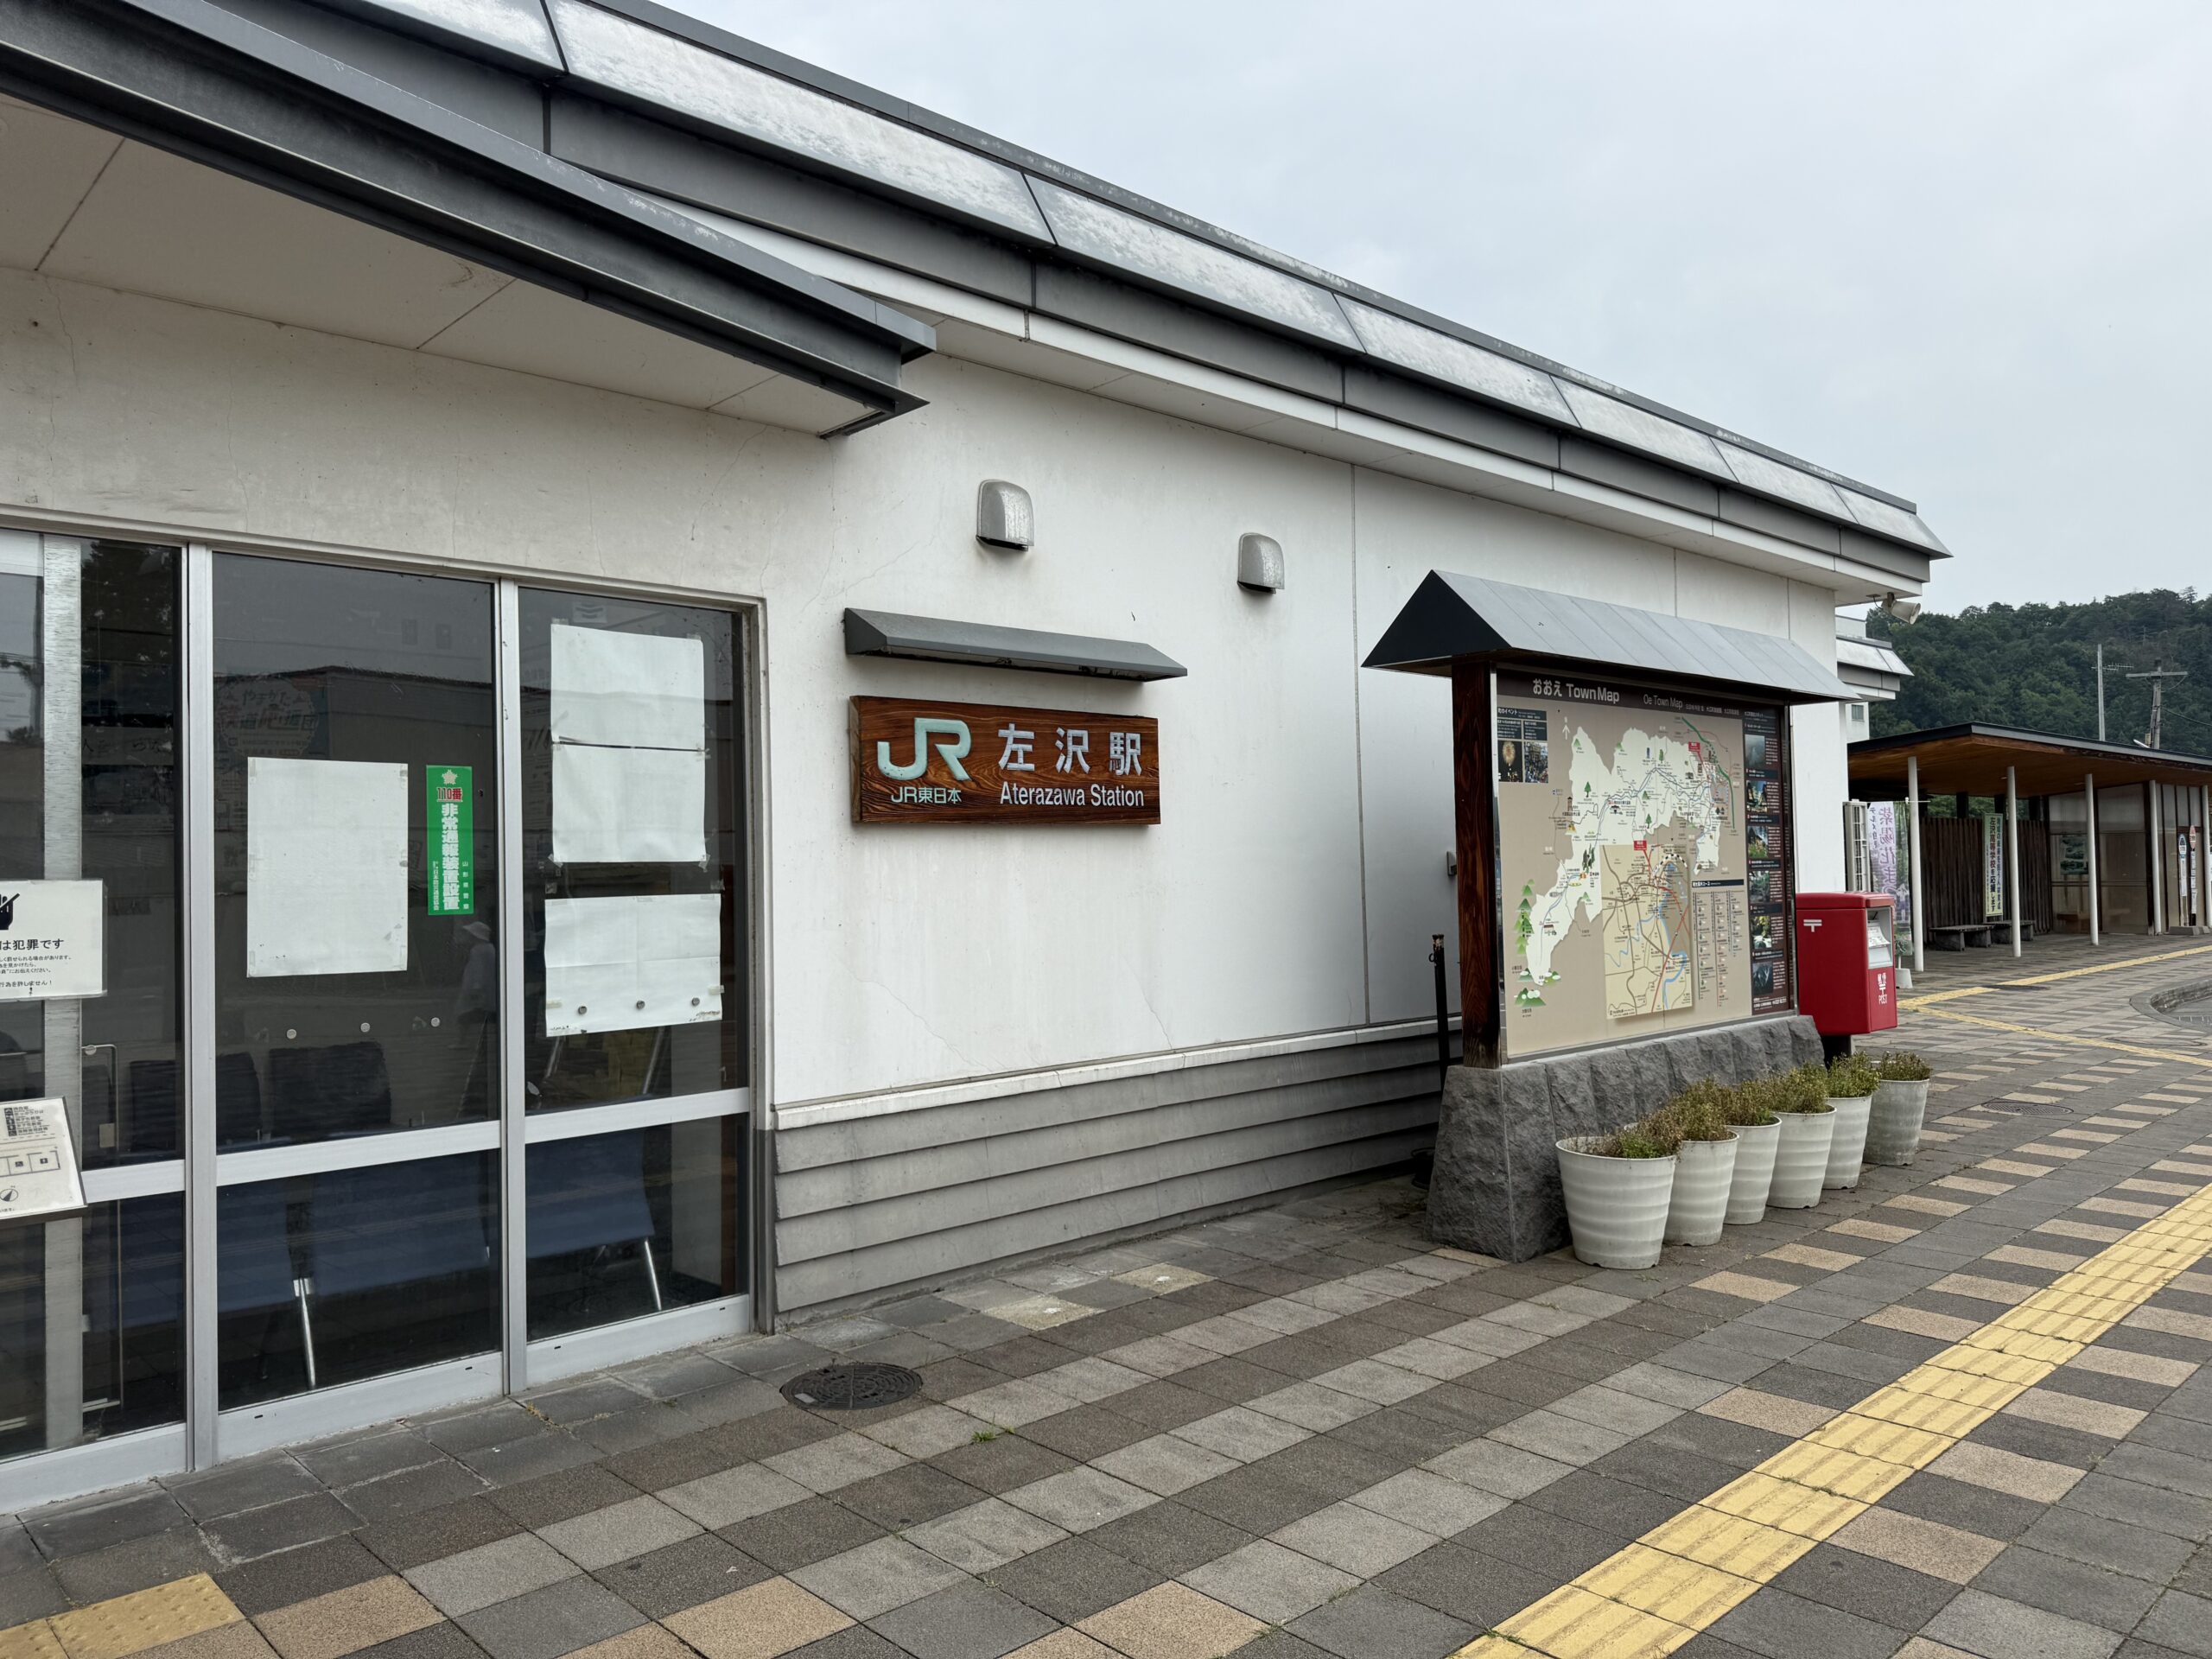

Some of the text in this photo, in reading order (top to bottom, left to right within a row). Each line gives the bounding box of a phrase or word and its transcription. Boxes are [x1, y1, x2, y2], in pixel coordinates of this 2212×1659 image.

[1533, 677, 1562, 697] おおえ
[1643, 694, 1652, 705] Oe
[1653, 695, 1669, 707] Town
[1669, 696, 1683, 710] Map
[877, 717, 972, 781] JR
[998, 722, 1142, 776] 左沢駅
[437, 787, 462, 801] 110番
[891, 786, 963, 804] JR東日本
[1000, 780, 1145, 807] Aterazawa Station
[0, 938, 65, 950] は犯罪です
[1878, 994, 1888, 1005] POST
